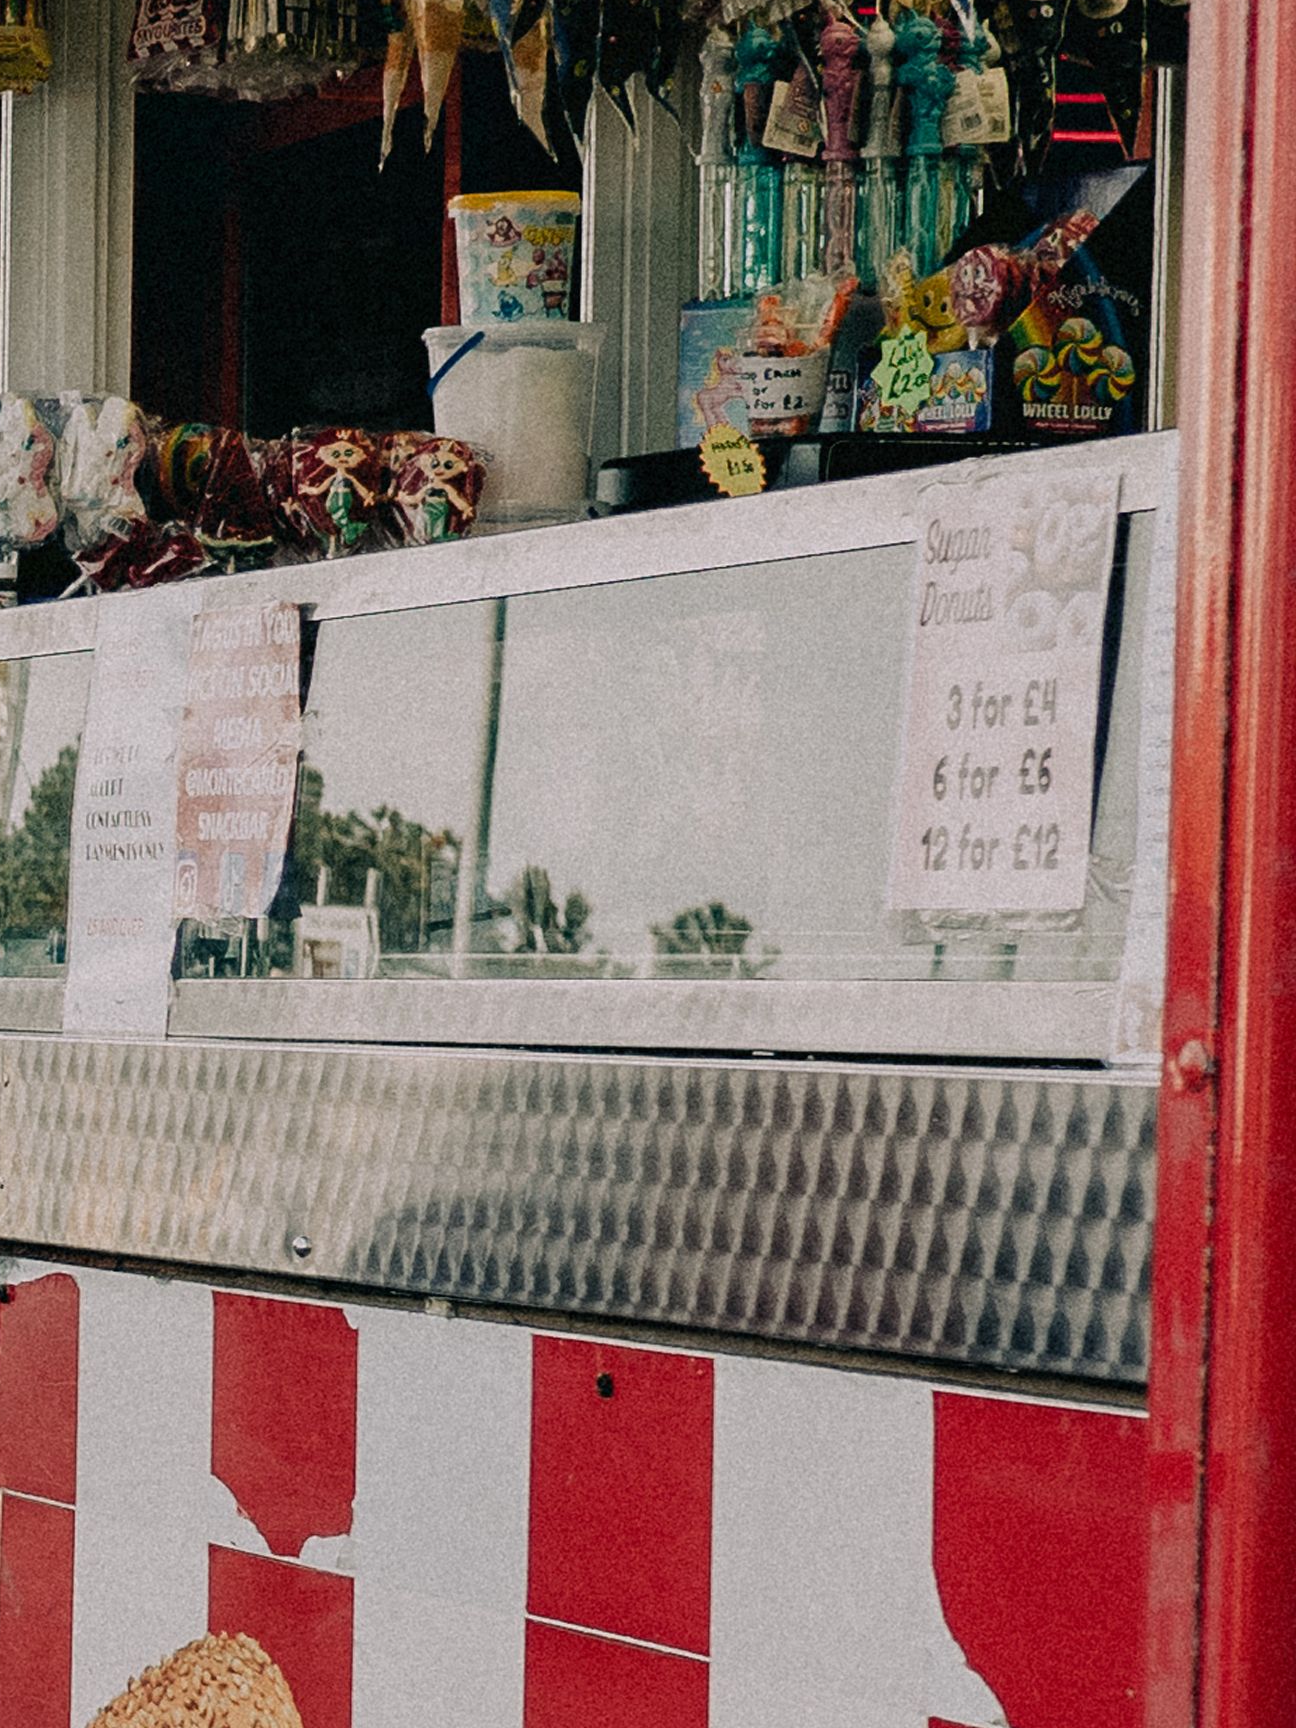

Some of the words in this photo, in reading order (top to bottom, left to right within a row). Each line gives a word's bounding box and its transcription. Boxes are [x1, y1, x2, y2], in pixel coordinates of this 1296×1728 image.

[1022, 403, 1070, 419] WHEEL
[1073, 404, 1113, 421] LOLLY
[925, 518, 993, 576] Sugar
[919, 581, 993, 628] Donuts
[945, 683, 963, 731] 3
[971, 680, 1012, 730] for
[1023, 677, 1058, 728] £4
[933, 754, 949, 803] 6
[957, 752, 1000, 801] for
[1018, 746, 1054, 797] £6
[85, 809, 153, 831] CONTACTLESS
[920, 824, 950, 872] 12
[958, 823, 1001, 871] for
[1011, 822, 1062, 872] £12
